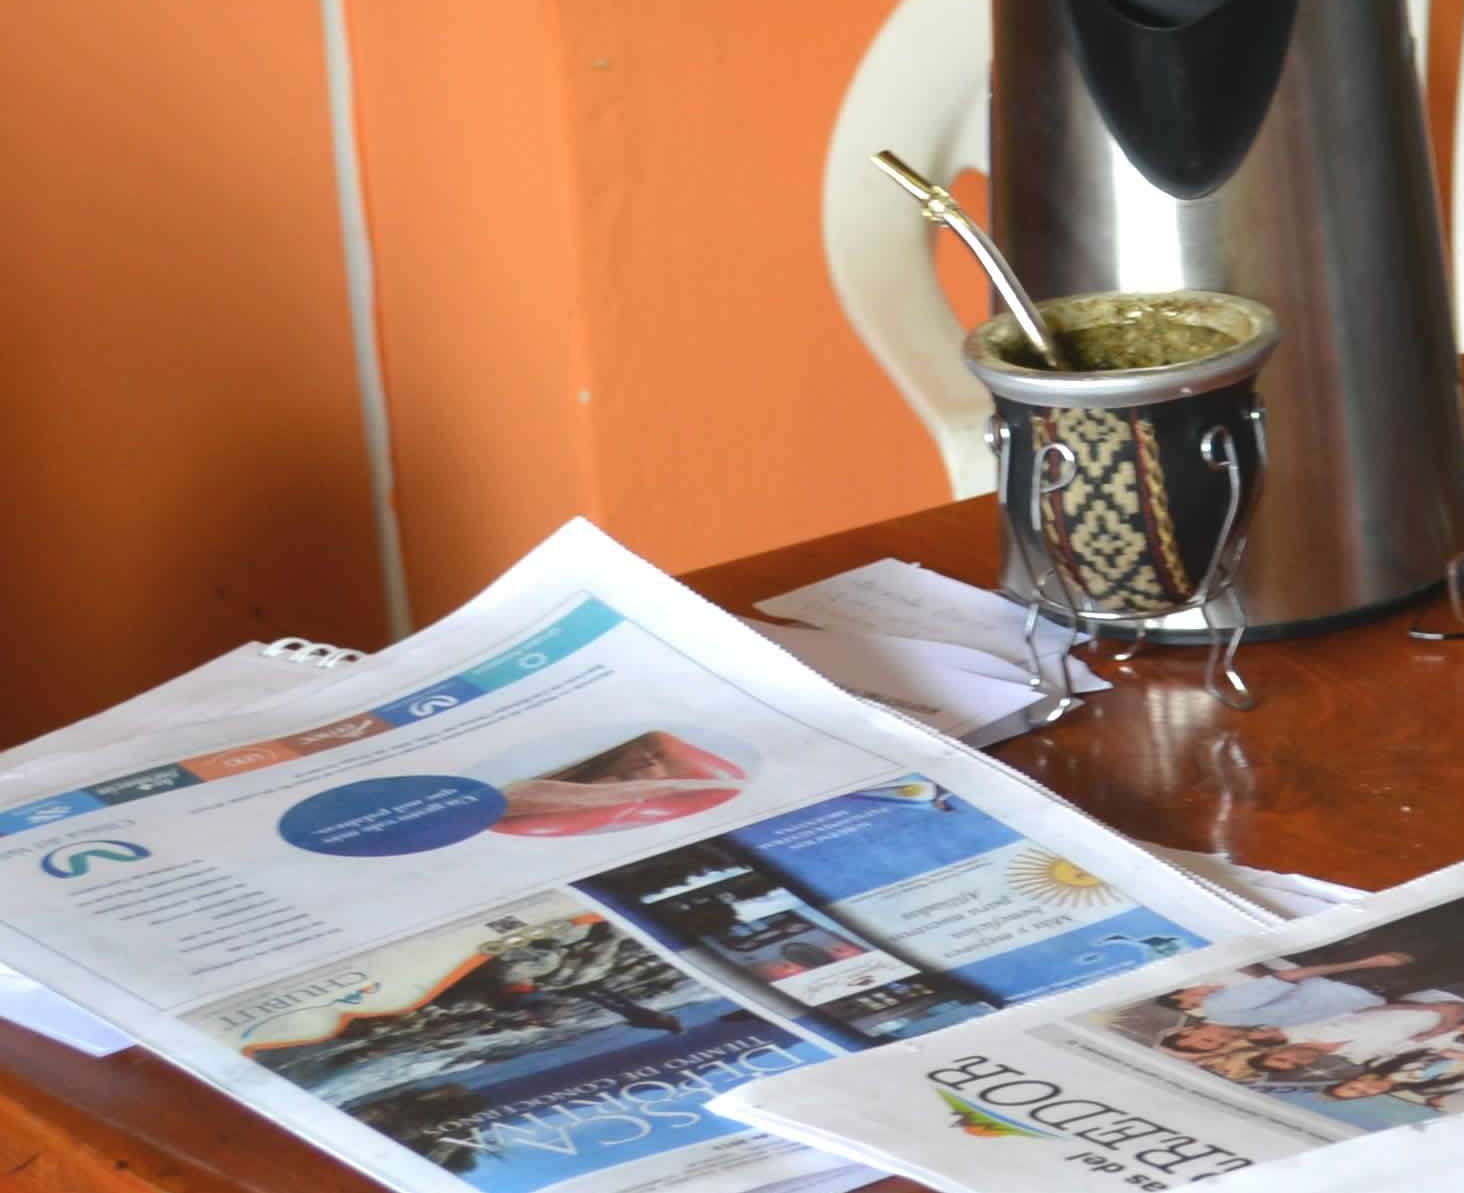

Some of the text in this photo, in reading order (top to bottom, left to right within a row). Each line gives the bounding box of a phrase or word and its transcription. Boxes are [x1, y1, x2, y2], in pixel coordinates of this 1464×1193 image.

[218, 970, 370, 1033] CHUBUT
[621, 1064, 660, 1085] DE
[663, 1035, 776, 1074] TIEMPO
[438, 1043, 806, 1153] DEPORTIVA
[512, 1101, 702, 1157] SCA
[1064, 1151, 1169, 1193] as del
